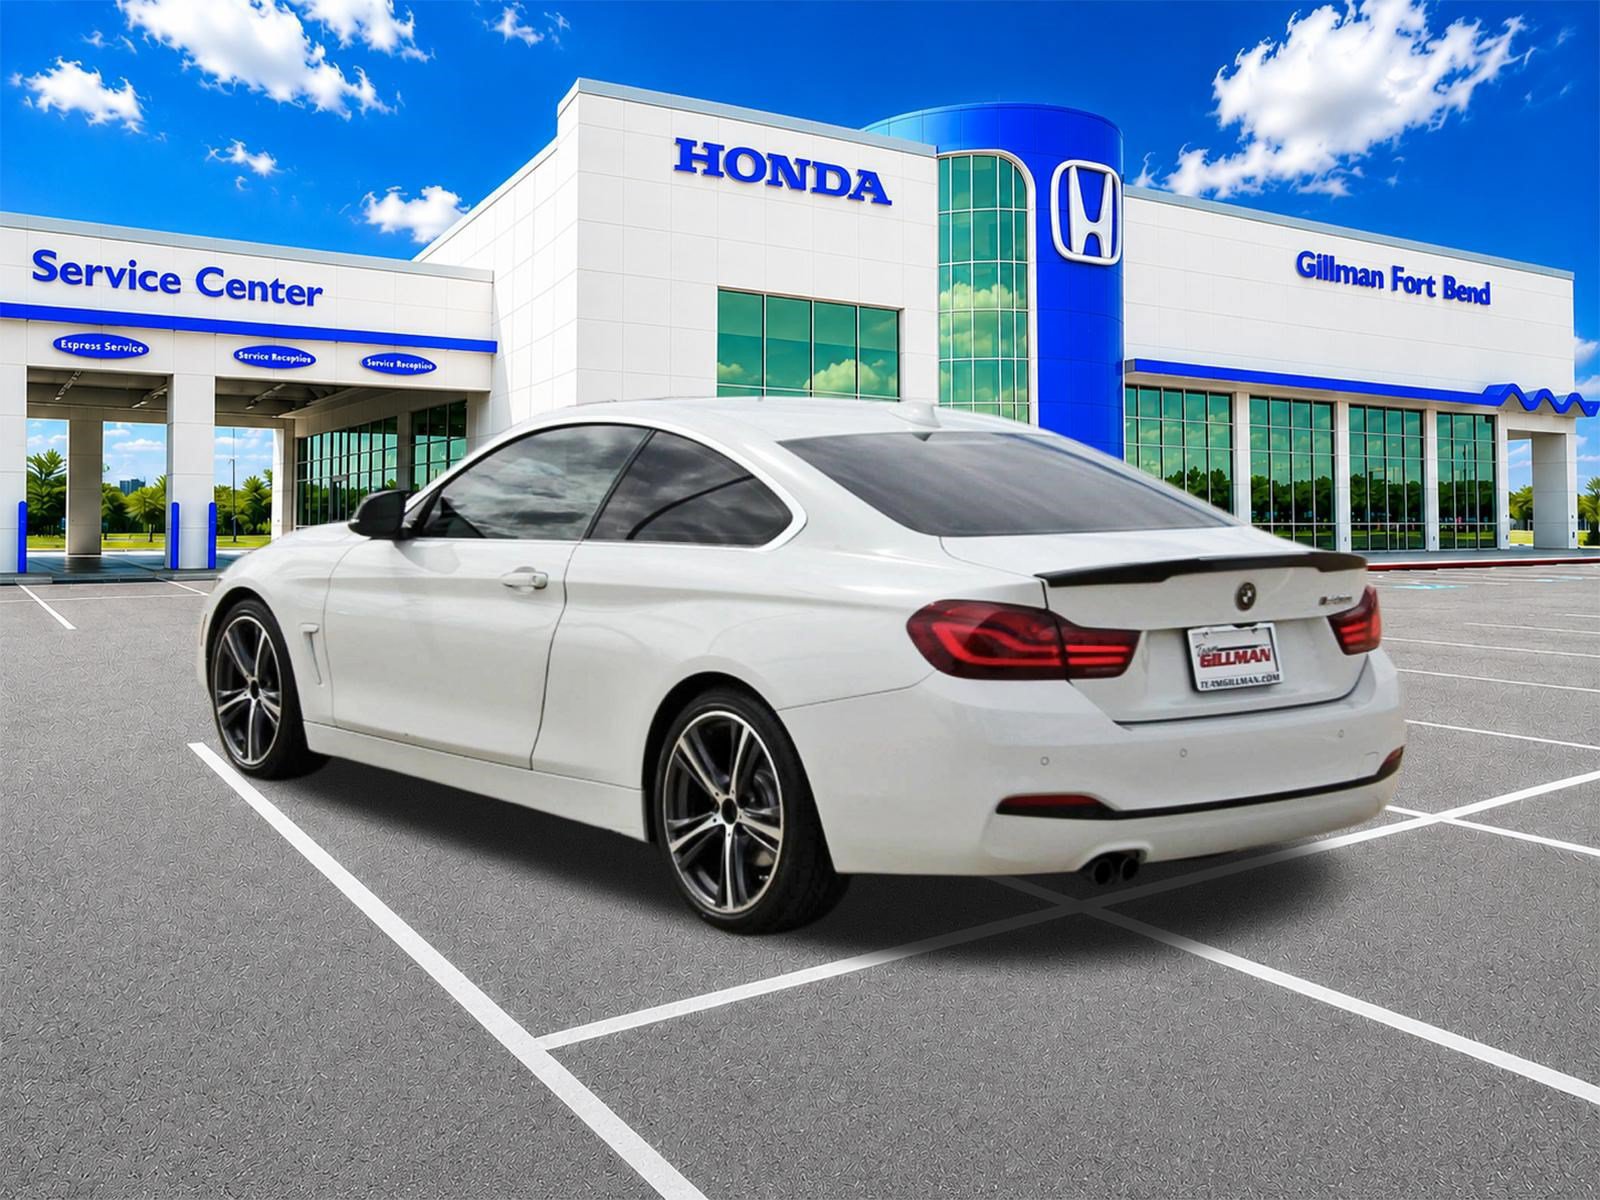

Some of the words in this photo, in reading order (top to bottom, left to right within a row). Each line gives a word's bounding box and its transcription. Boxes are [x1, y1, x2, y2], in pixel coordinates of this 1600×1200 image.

[674, 137, 893, 206] HONDA
[31, 248, 182, 295] Service
[195, 266, 324, 307] Center
[1296, 250, 1385, 290] Gillman
[1390, 265, 1436, 298] Fort
[1442, 275, 1492, 306] Bend
[104, 342, 144, 354] Service
[238, 351, 269, 361] Service
[366, 358, 394, 368] Service
[1199, 647, 1271, 668] GILLMAN
[1200, 673, 1281, 689] TEAMGILLMAN.COM
